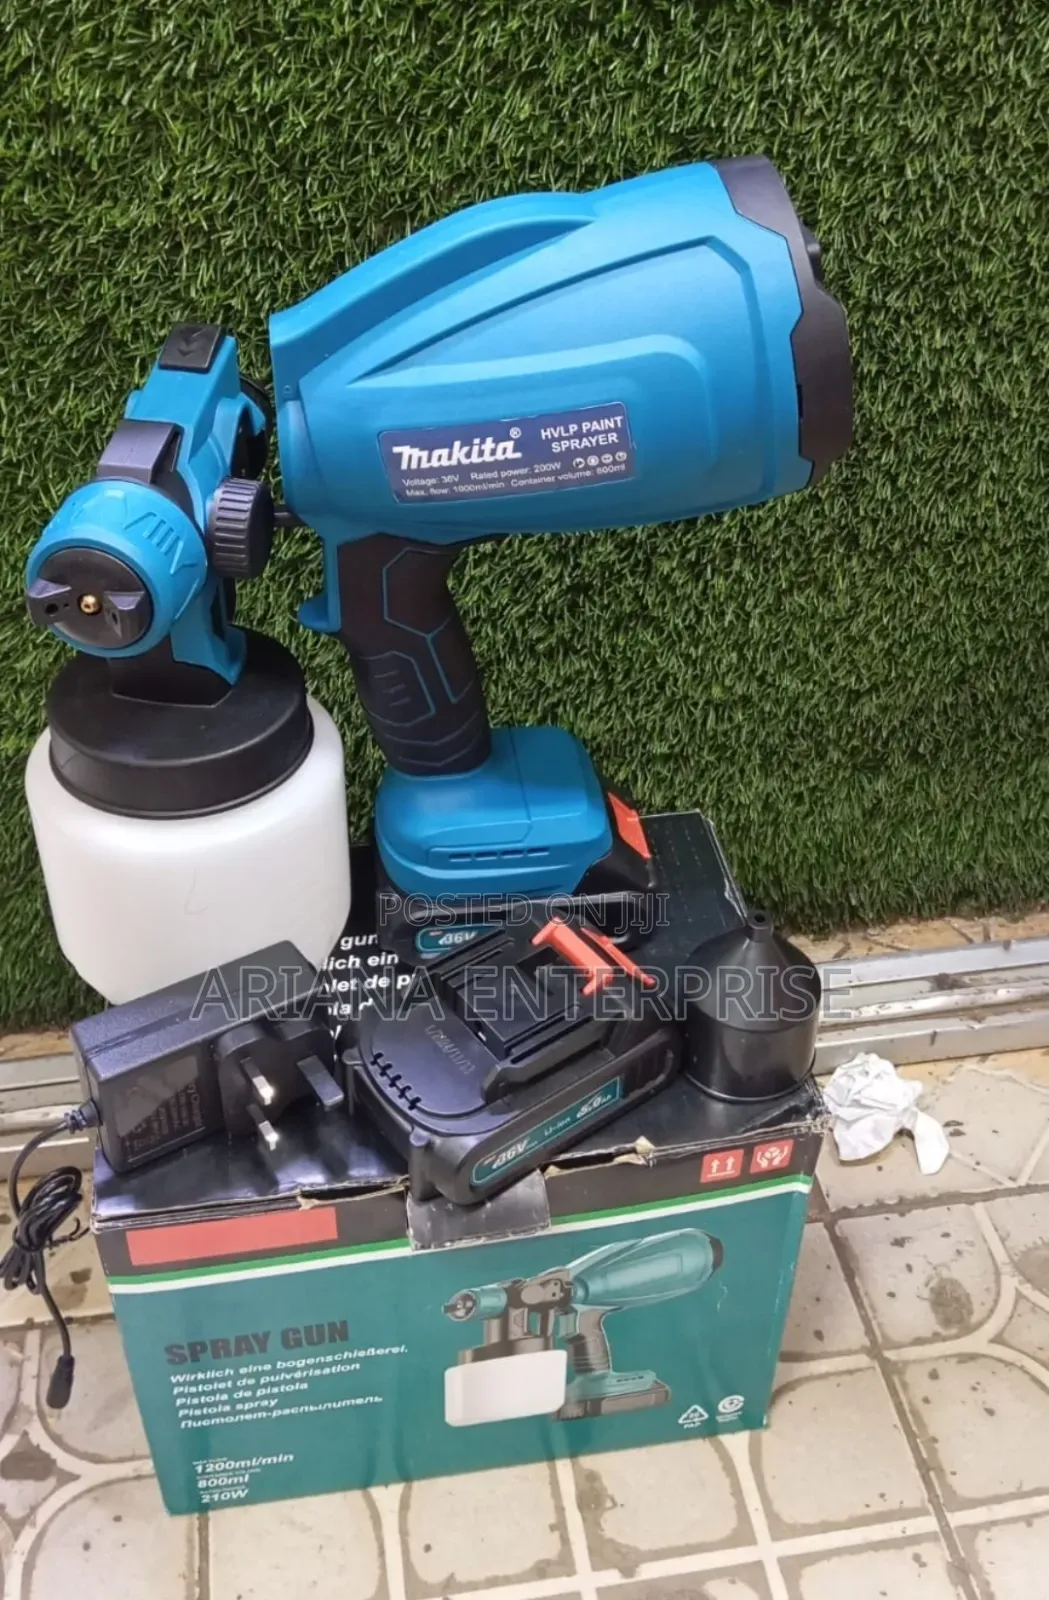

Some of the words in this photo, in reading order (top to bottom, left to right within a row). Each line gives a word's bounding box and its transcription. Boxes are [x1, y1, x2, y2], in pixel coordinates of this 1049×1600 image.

[541, 423, 579, 440] HVLP
[581, 416, 624, 433] PAINT
[551, 432, 619, 453] SPRAYER
[470, 470, 499, 480] Rated
[500, 466, 532, 479] power:
[533, 461, 562, 473] 200W
[510, 475, 556, 487] Container
[557, 468, 595, 481] volume:
[164, 1330, 271, 1366] SPRAY
[281, 1319, 350, 1351] GUN
[170, 1367, 235, 1384] Wirklich
[238, 1363, 272, 1375] eine
[172, 1379, 234, 1396] Pistolet
[236, 1377, 256, 1387] de
[259, 1361, 361, 1386] pulvérisation
[175, 1392, 229, 1408] Pistola
[233, 1389, 253, 1400] de
[255, 1381, 309, 1398] pistola
[178, 1403, 232, 1418] Pistola
[235, 1397, 279, 1411] spray
[194, 1453, 295, 1475] 1200ml/min
[197, 1473, 250, 1489] 800ml
[200, 1488, 250, 1504] 210W
